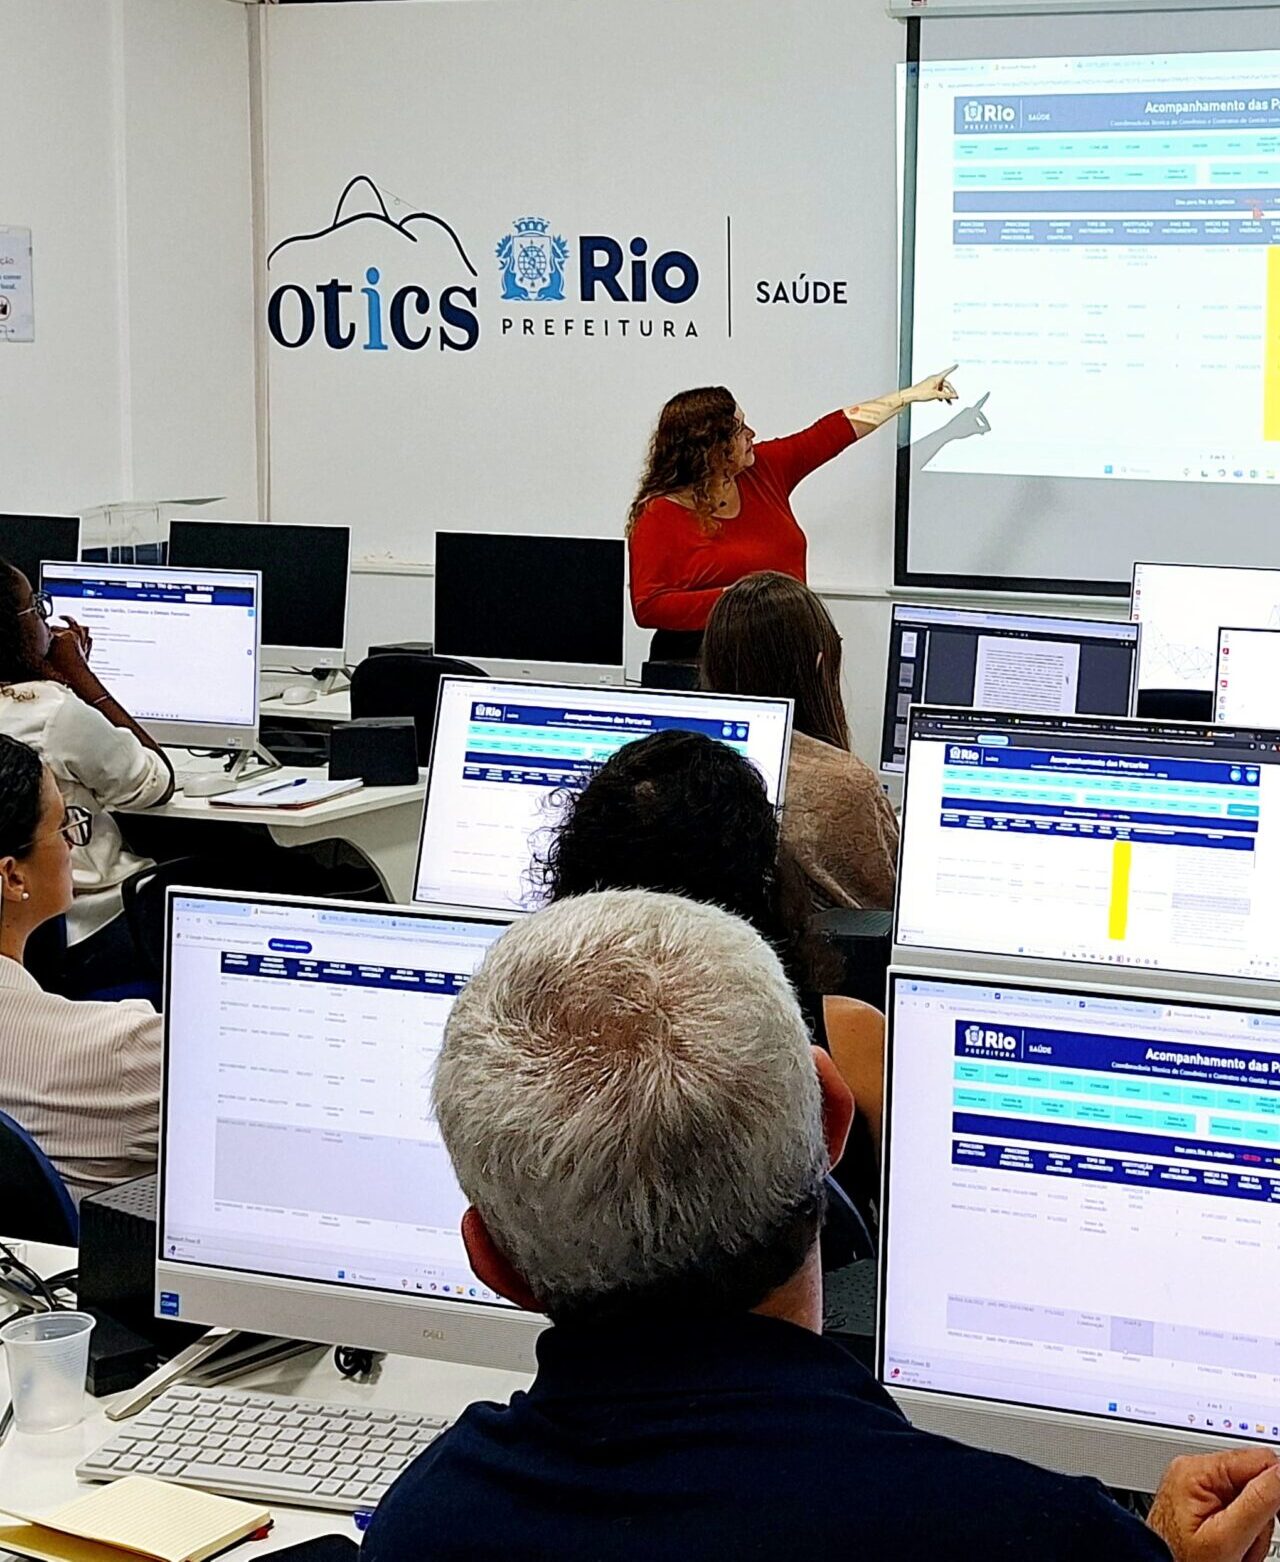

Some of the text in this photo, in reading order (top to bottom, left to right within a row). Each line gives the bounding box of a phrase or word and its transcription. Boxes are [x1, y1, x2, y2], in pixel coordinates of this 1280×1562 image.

[984, 104, 1015, 122] Rio
[1145, 101, 1245, 115] Acompanhamento
[1248, 99, 1268, 111] das
[579, 236, 698, 303] Rio
[757, 273, 847, 304] SAÚDE
[267, 267, 480, 351] otics
[502, 319, 698, 337] PREFEITURA
[486, 706, 502, 718] Rio
[961, 749, 979, 760] Rio
[985, 1030, 1016, 1050] Rio
[1146, 1048, 1246, 1070] Acompanhamento
[1248, 1059, 1269, 1073] das
